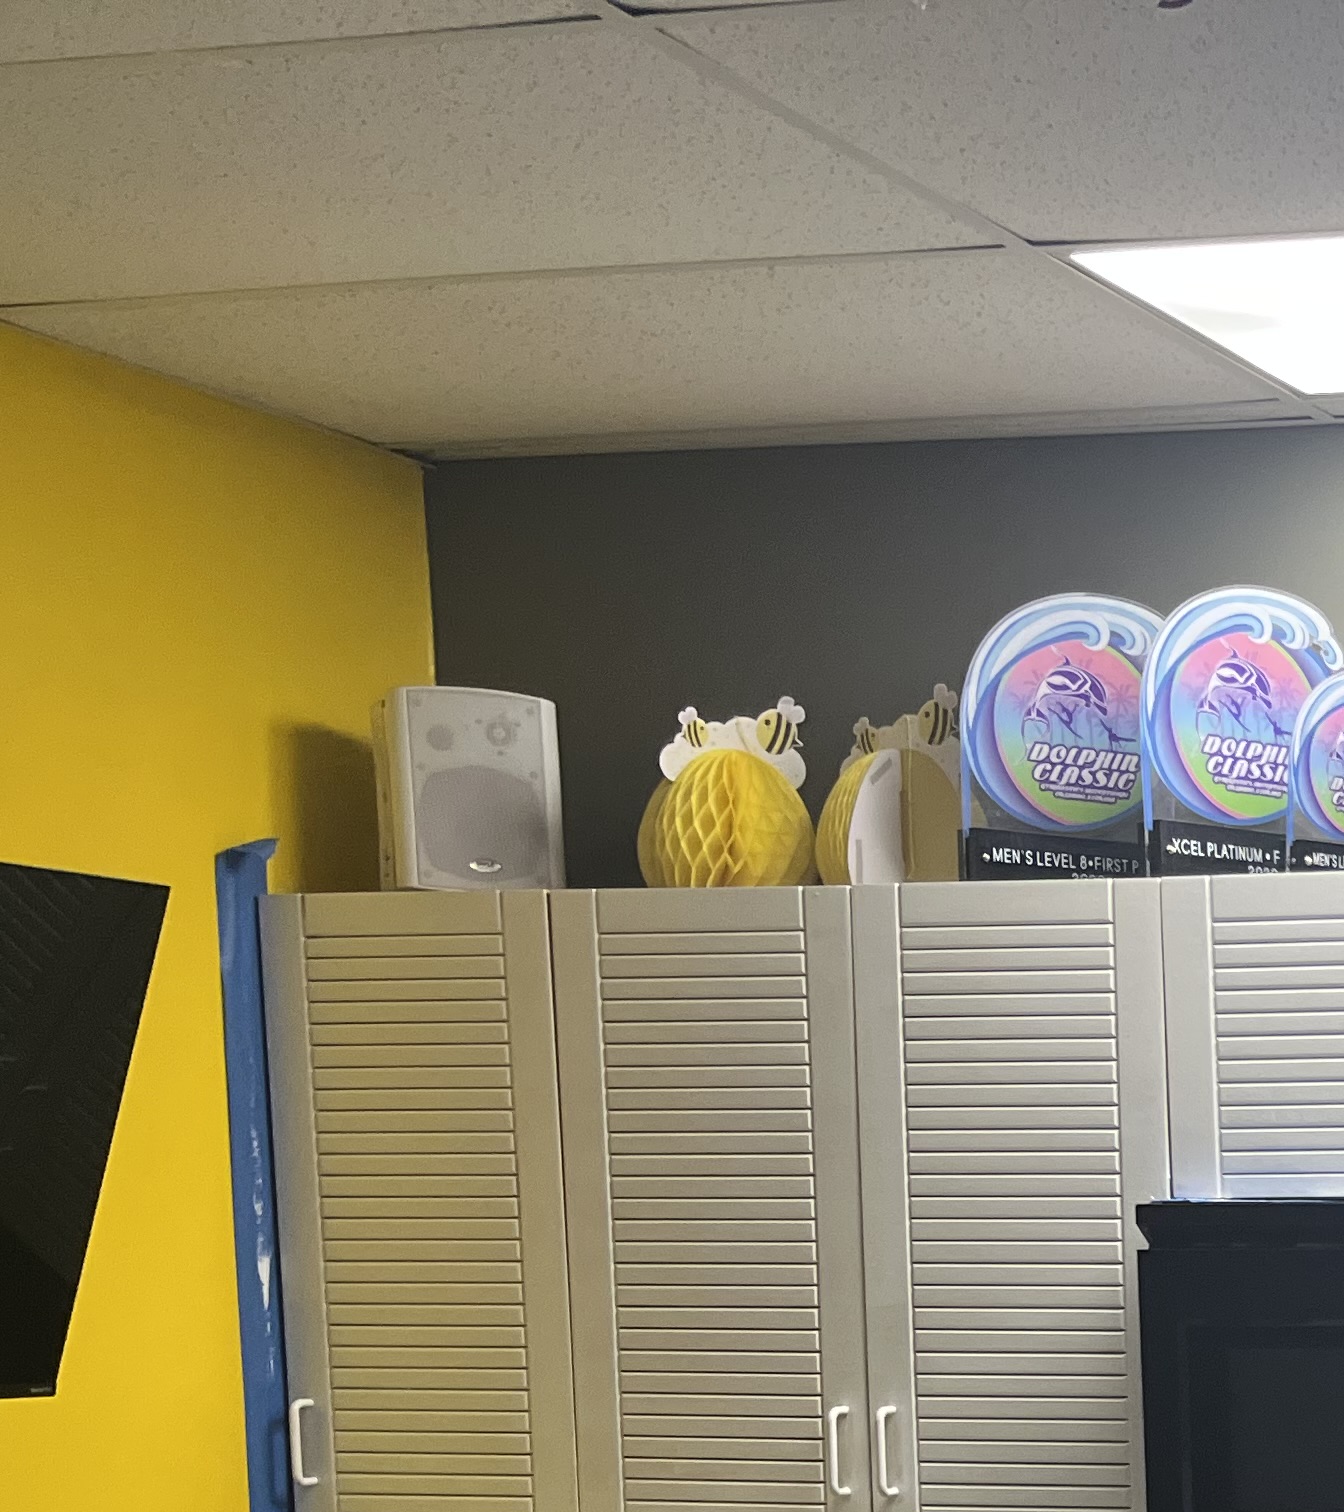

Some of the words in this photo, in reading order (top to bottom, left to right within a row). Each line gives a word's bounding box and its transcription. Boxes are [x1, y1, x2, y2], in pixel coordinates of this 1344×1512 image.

[1029, 743, 1140, 773] DOLPHIN
[1203, 735, 1289, 764] DOLPHI
[1033, 763, 1136, 790] CLASSIC
[992, 847, 1034, 866] MEN'S
[1037, 851, 1076, 870] LEVEL
[1094, 857, 1128, 873] FIRST
[1207, 842, 1263, 863] PLATINUM
[1312, 852, 1337, 868] MEN'S
